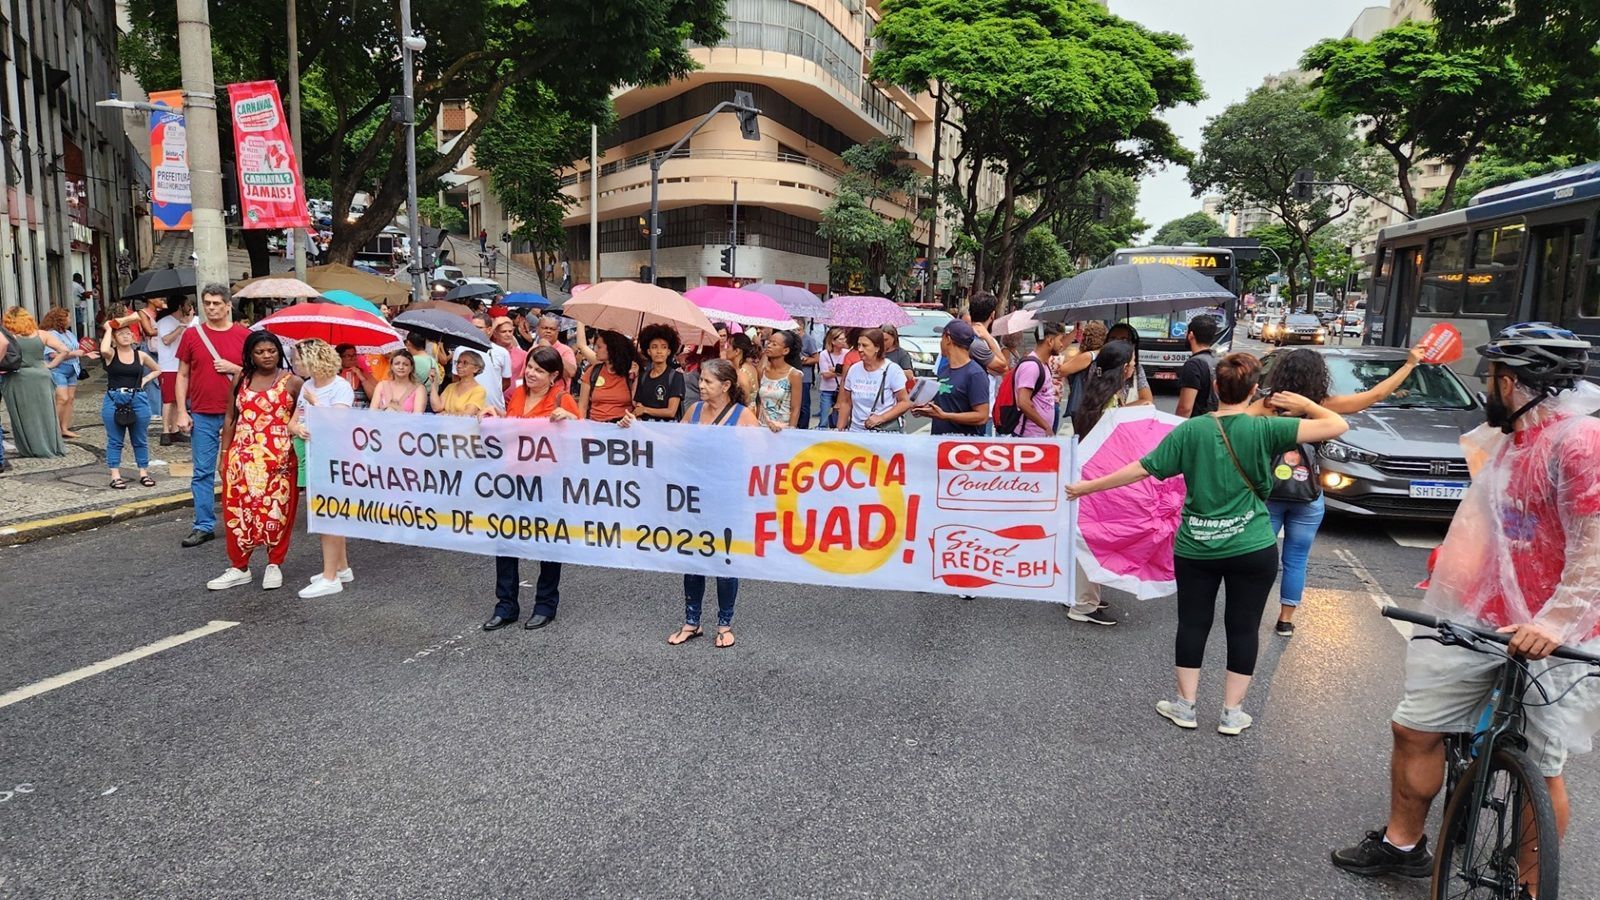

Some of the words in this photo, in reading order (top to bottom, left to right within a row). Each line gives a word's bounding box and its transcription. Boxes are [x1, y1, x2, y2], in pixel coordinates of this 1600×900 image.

[237, 98, 272, 114] CARNAVAL
[157, 171, 191, 182] PREFEITURA
[245, 173, 291, 185] CARNAVAL?
[246, 184, 292, 199] JAMAIS!
[1158, 256, 1217, 268] ANCHIETA
[352, 426, 382, 452] OS
[399, 431, 503, 460] COFRES
[518, 436, 557, 463] DA
[581, 438, 653, 469] PBH
[948, 443, 1045, 473] CSP
[329, 459, 462, 496] FECHARAM
[474, 472, 543, 502] COM
[562, 477, 641, 509] MAIS
[666, 484, 701, 514] DE
[748, 452, 907, 497] NEGOCIA
[946, 473, 1043, 497] Conlutas
[315, 494, 350, 520] 204
[357, 500, 438, 530] MILHÕES
[452, 510, 474, 535] DE
[486, 513, 570, 545] SOBRA
[584, 520, 621, 549] EM
[754, 494, 921, 564] FUAD!
[945, 529, 1021, 559] Sind
[942, 551, 1048, 578] REDE-BH
